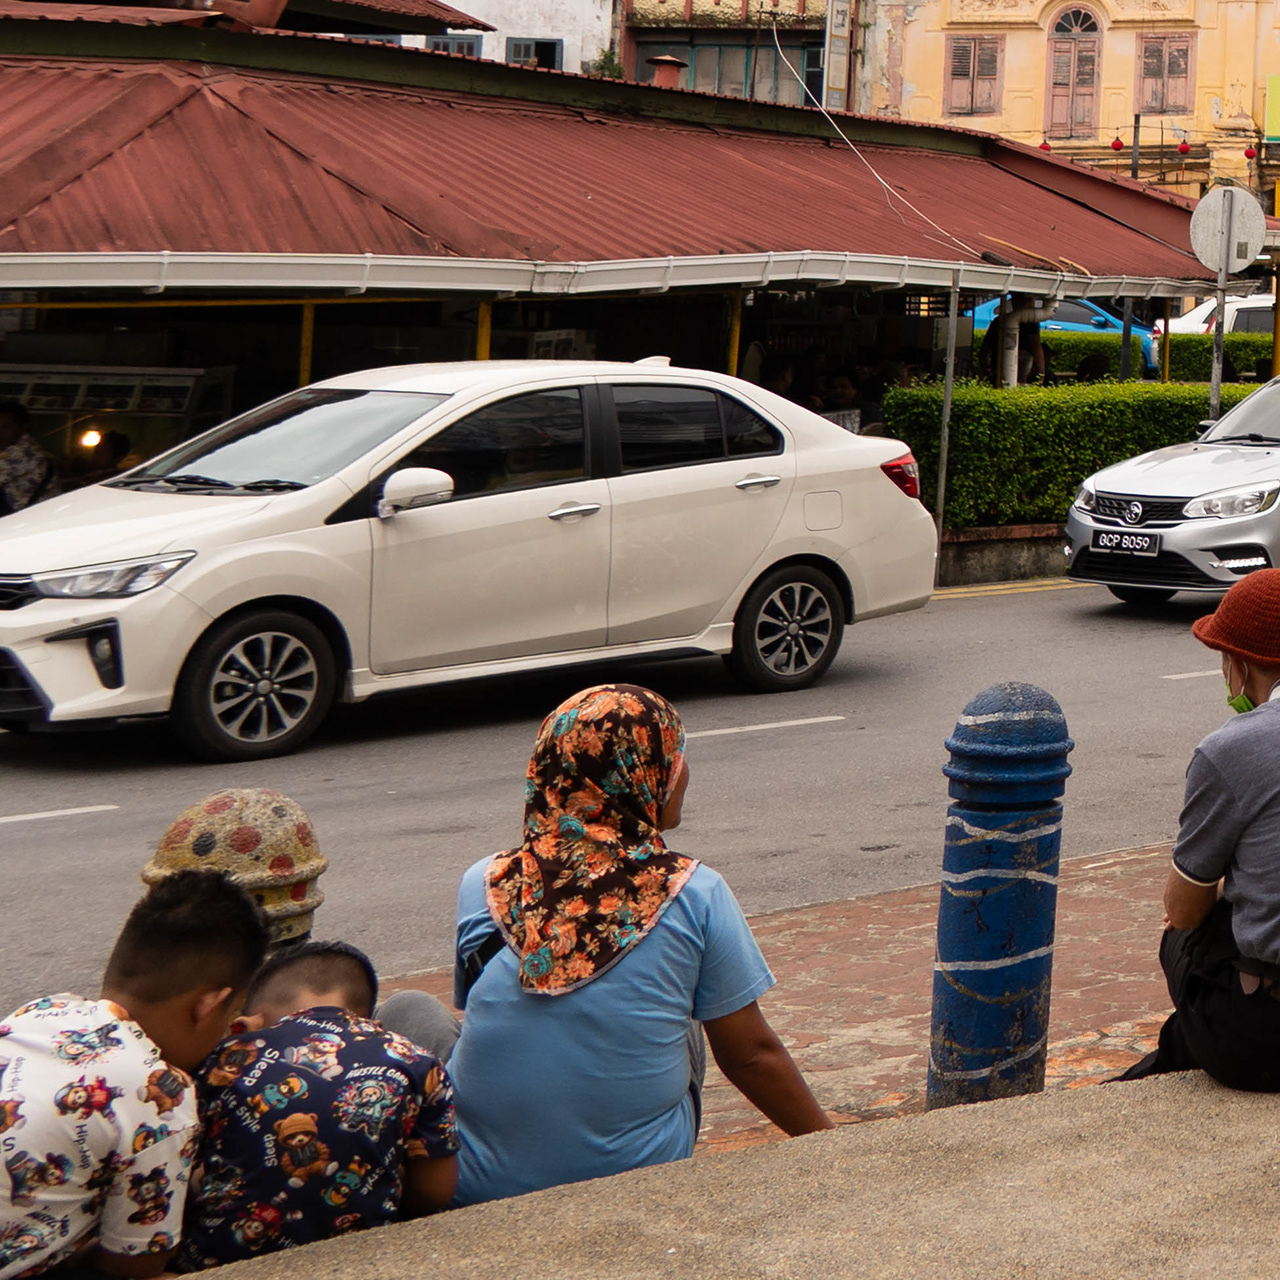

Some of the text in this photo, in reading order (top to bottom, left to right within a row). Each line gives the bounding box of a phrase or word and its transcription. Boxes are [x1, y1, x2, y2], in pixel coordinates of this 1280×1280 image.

[1121, 535, 1150, 549] 8059
[297, 1016, 344, 1033] Hip-Hop
[242, 1047, 280, 1087] Sleep
[264, 1133, 278, 1168] Sleep
